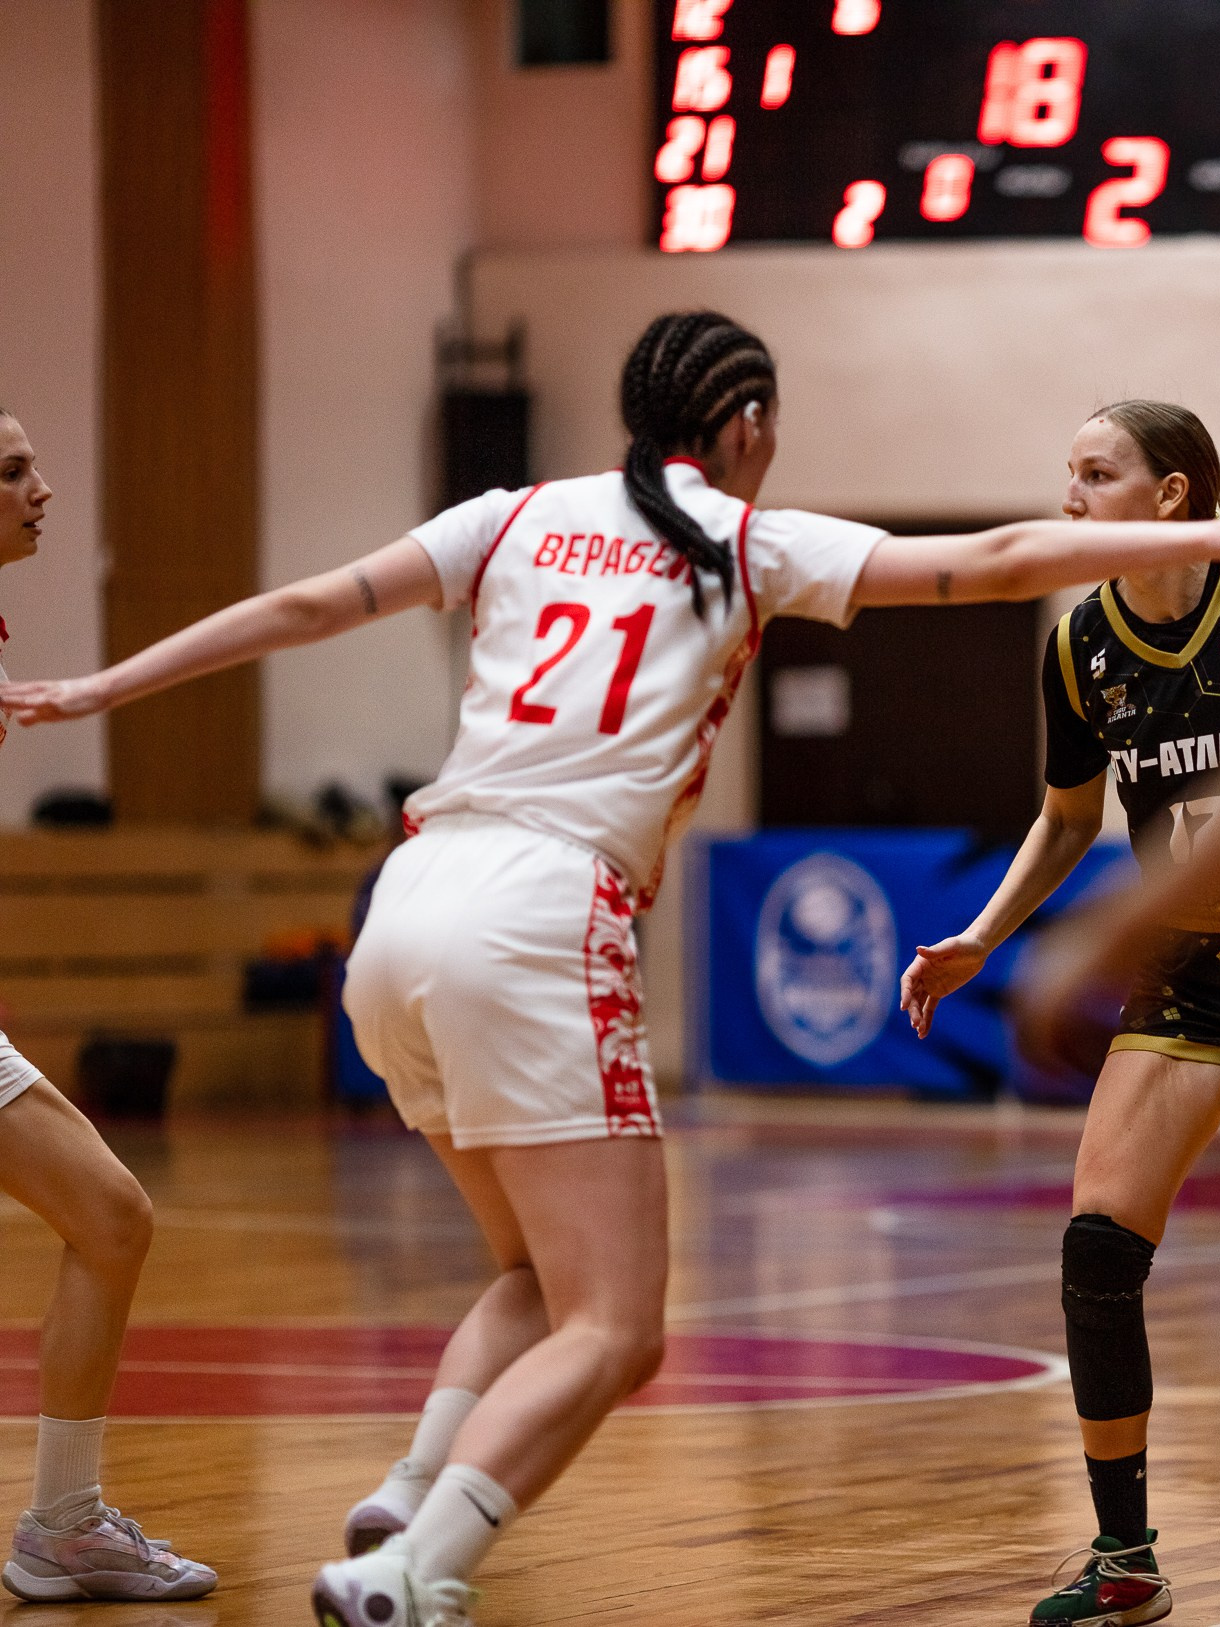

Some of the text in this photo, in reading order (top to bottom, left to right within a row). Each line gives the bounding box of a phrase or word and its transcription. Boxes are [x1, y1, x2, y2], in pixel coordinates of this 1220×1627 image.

[760, 43, 797, 110] 1
[978, 37, 1088, 147] 18
[653, 115, 737, 183] 21
[1083, 136, 1170, 248] 2
[832, 179, 887, 249] 2
[507, 602, 656, 736] 21
